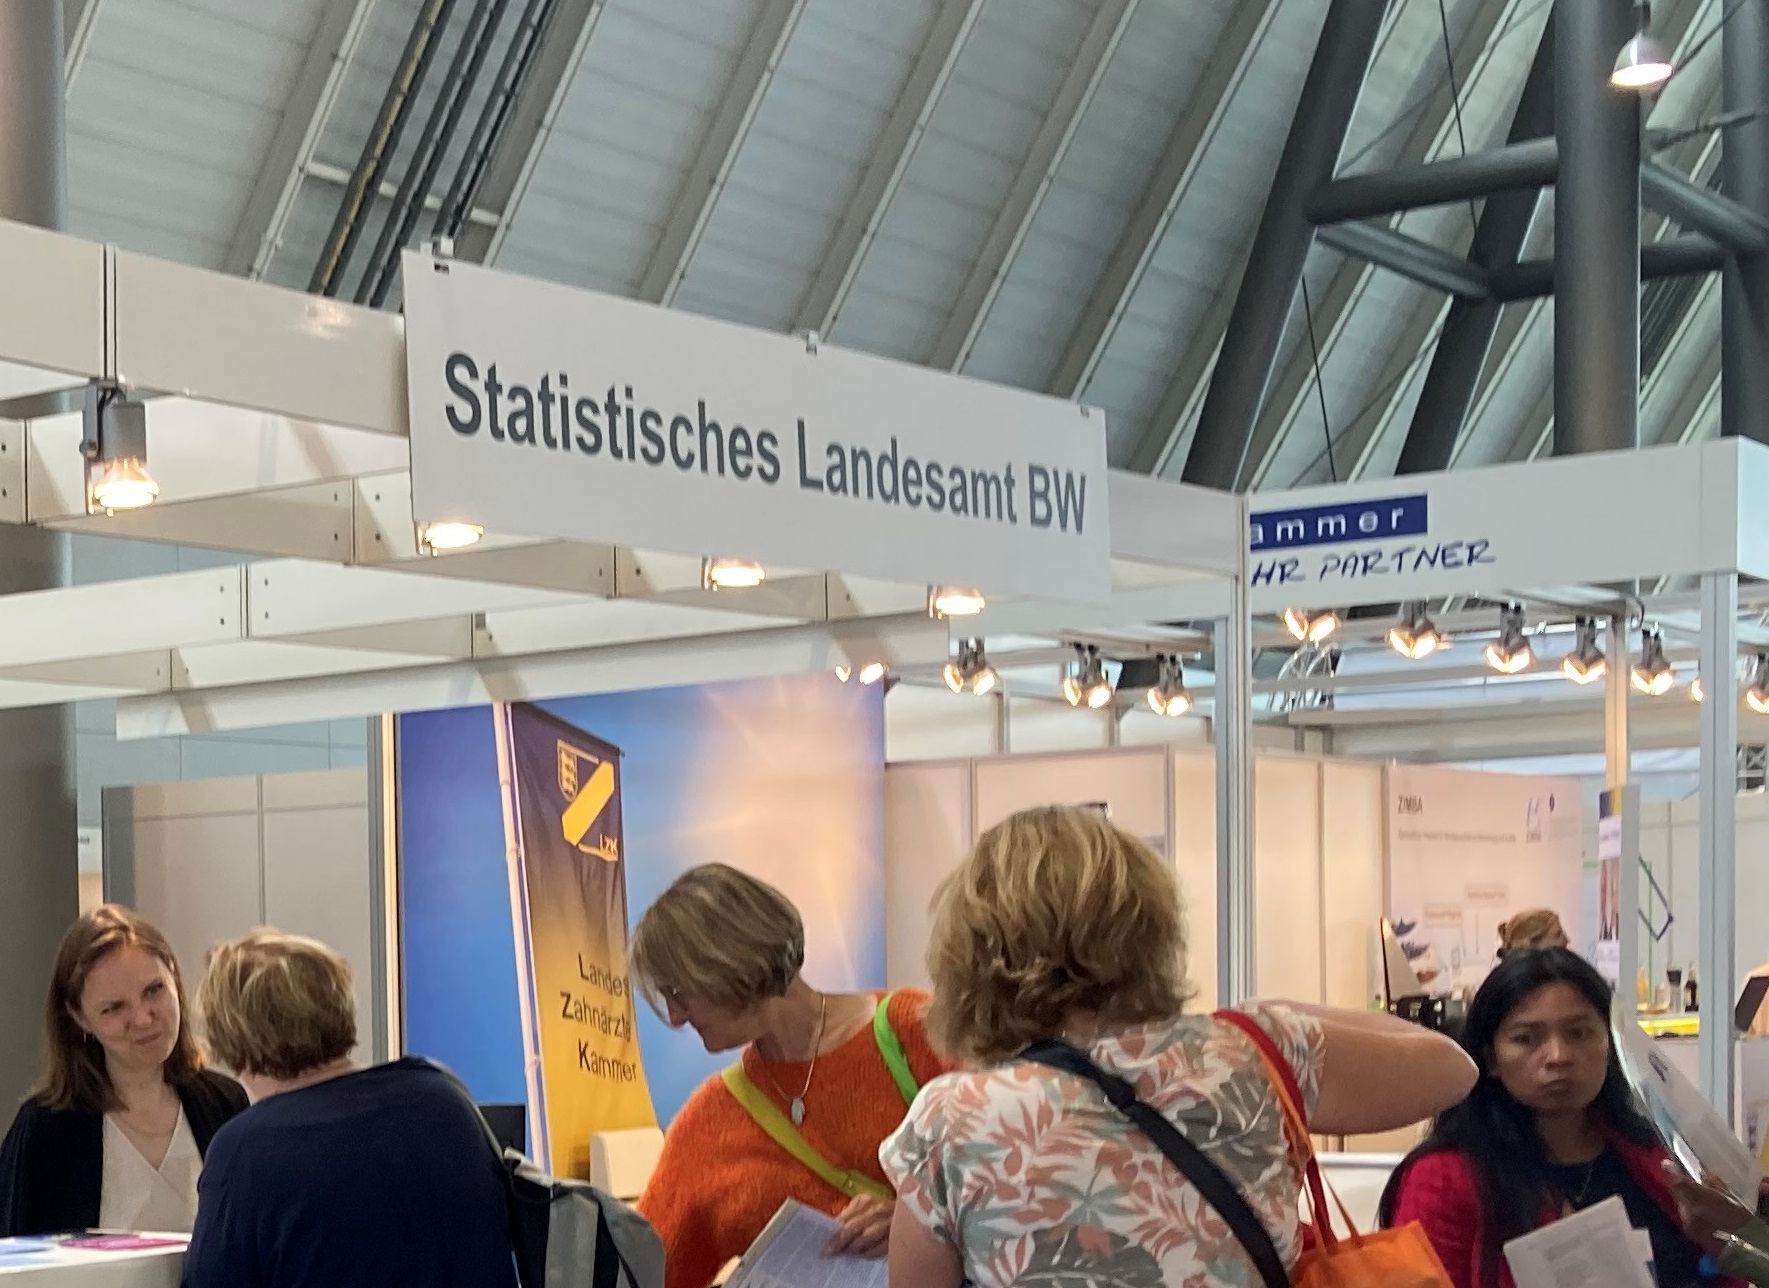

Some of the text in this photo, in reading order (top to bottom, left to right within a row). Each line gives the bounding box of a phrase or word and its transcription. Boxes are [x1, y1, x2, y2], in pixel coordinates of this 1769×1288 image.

[443, 351, 1089, 535] Statistisches Landesamt BW
[1319, 538, 1497, 582] PARTNER
[578, 1038, 637, 1083] Kammer
